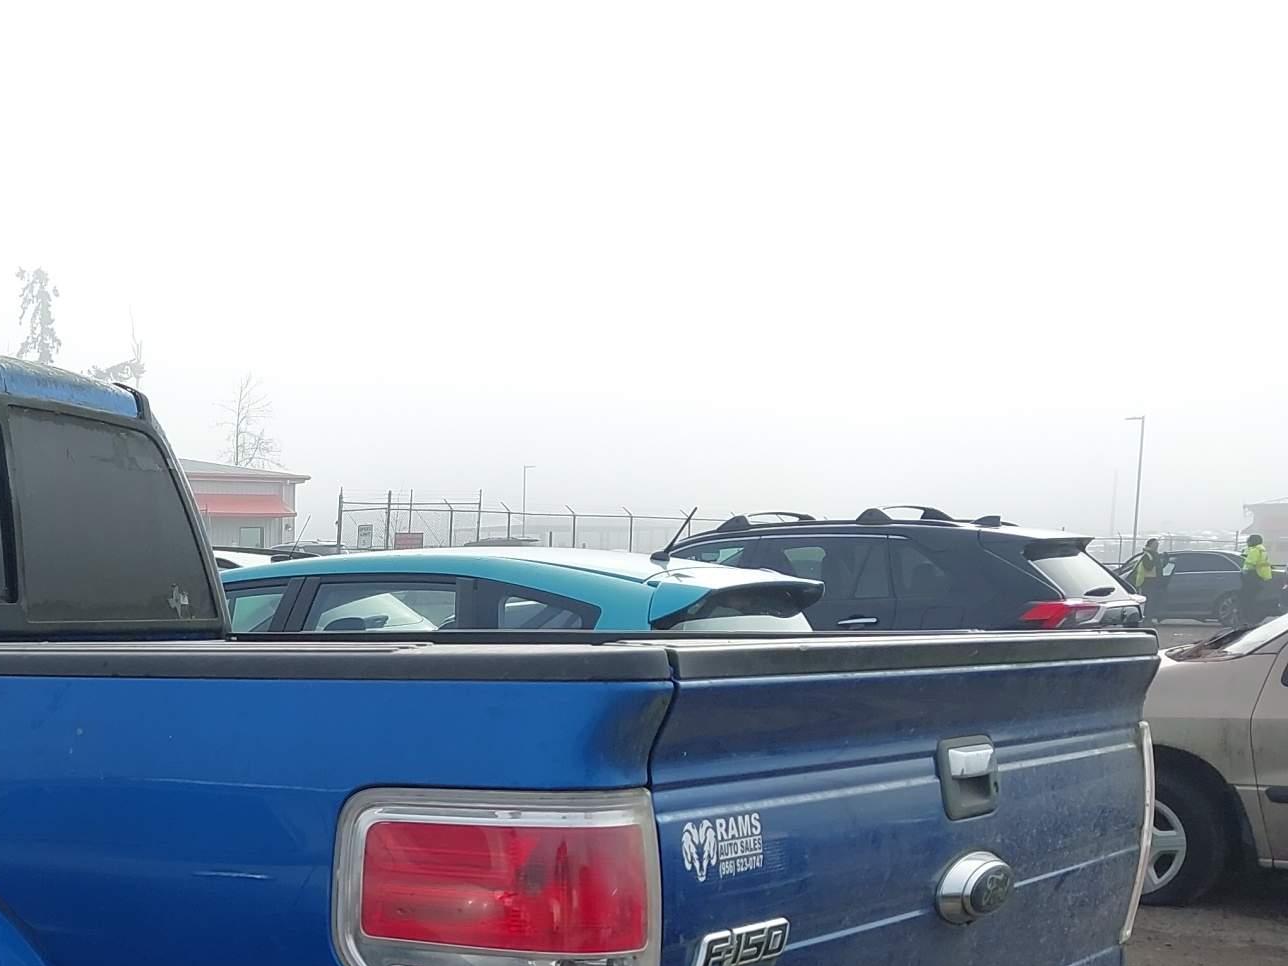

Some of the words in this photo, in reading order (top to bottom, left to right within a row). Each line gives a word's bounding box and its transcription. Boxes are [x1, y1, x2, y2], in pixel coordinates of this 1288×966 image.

[715, 813, 761, 840] RAMS
[719, 841, 739, 858] AUTO
[740, 837, 762, 853] SALES
